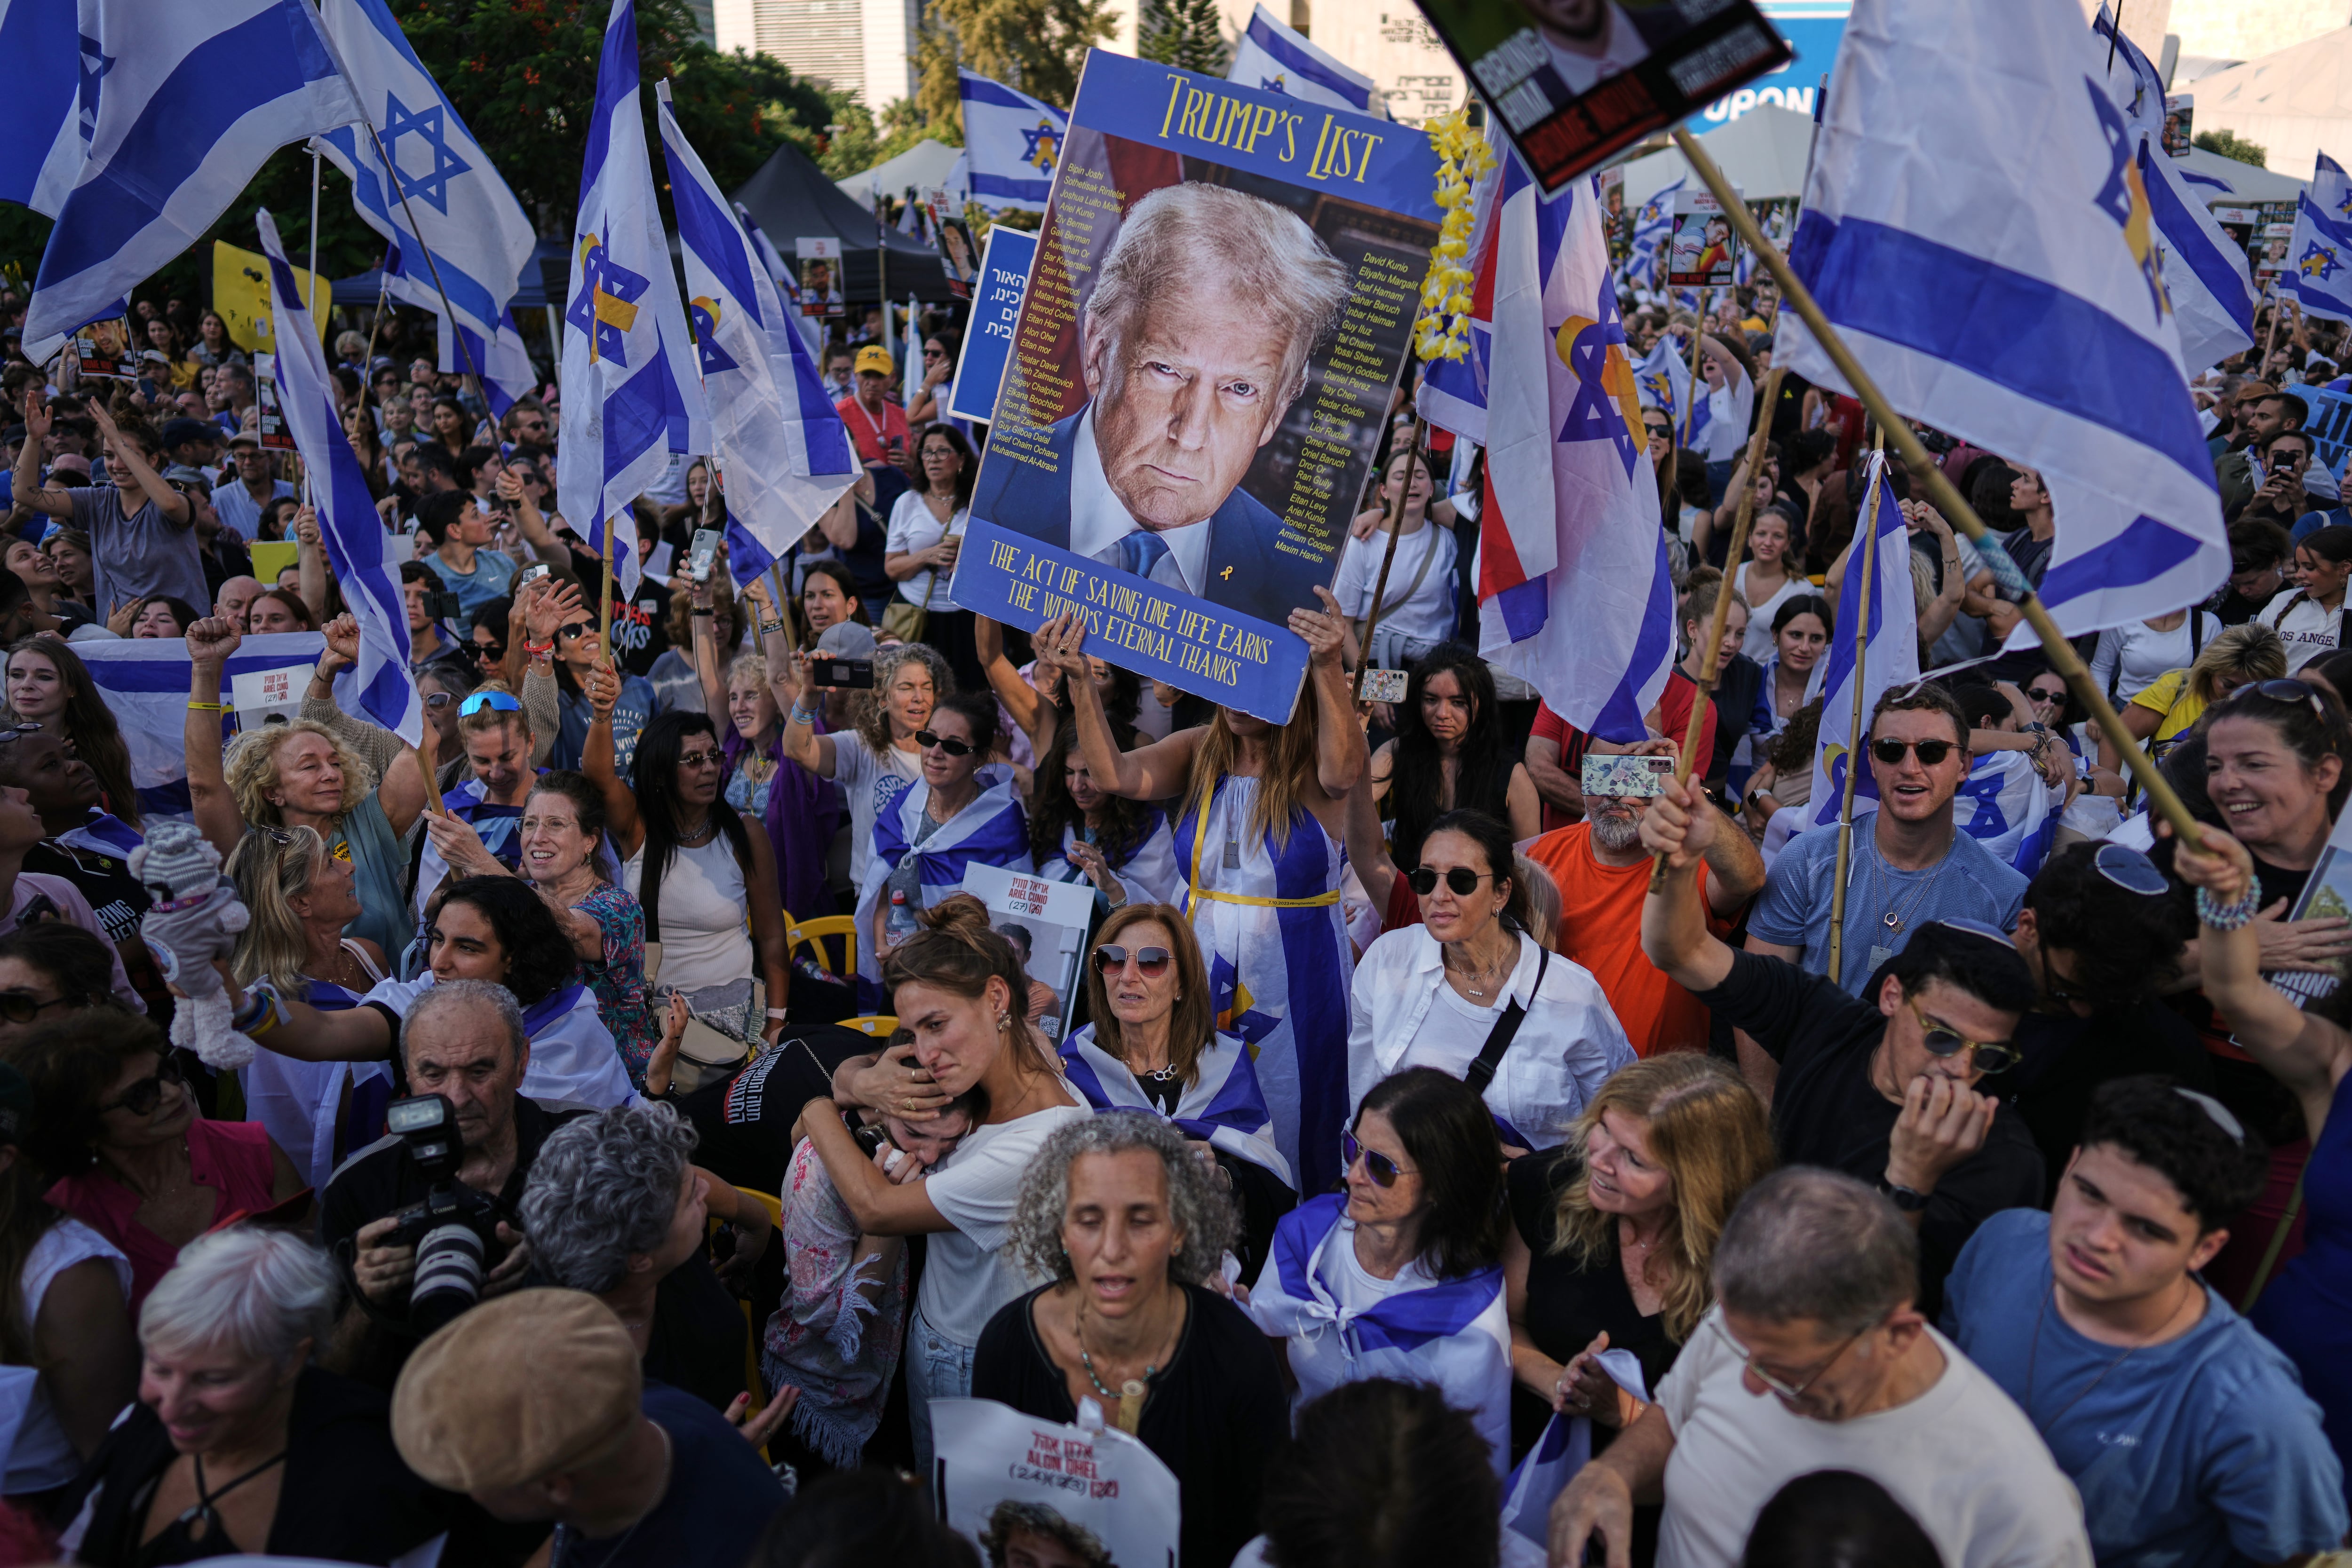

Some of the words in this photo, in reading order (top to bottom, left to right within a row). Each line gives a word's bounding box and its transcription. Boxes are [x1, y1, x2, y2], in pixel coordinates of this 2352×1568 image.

[1472, 26, 1549, 97] BRING
[1496, 78, 1553, 135] HIM
[1306, 114, 1383, 183] LIST
[1067, 163, 1085, 174] Bipin
[1085, 168, 1104, 180] Joshi
[1064, 176, 1097, 191] Sothetisak
[1099, 186, 1126, 200] Rintelak
[1060, 190, 1084, 202] Joshua
[1085, 197, 1101, 207] Luito
[1103, 201, 1124, 213] Mollel
[1060, 203, 1075, 212] Ariel
[1076, 207, 1095, 219] Kunio
[1067, 218, 1093, 231] Berman
[1050, 226, 1064, 236] Gali
[1065, 231, 1091, 245] Berman
[1047, 239, 1080, 254] Avinathan
[1081, 249, 1090, 258] Or
[1043, 251, 1056, 261] Bar
[1057, 256, 1091, 273] Kuperstein
[1363, 253, 1387, 266] David
[1386, 260, 1409, 273] Kunio
[1041, 264, 1057, 275] Omri
[1058, 270, 1076, 281] Miran
[1359, 267, 1387, 282] Eliyahu
[1387, 274, 1418, 290] Margalit
[1670, 274, 1686, 282] HOME
[990, 288, 1025, 304] כינו,
[1037, 277, 1054, 287] Tamir
[1055, 283, 1081, 296] Nimrodi
[1354, 280, 1374, 292] Asaf
[1373, 287, 1406, 301] Hamami
[1034, 289, 1055, 301] Matan
[1056, 297, 1081, 309] angrest
[1350, 293, 1373, 306] Sahar
[1374, 301, 1400, 315] Baruch
[1026, 313, 1043, 324] Eitan
[1030, 301, 1054, 315] Nimrod
[1055, 309, 1076, 322] Cohen
[1346, 307, 1367, 318] Inbar
[1367, 313, 1397, 328] Haiman
[1024, 326, 1039, 336] Alon
[1041, 331, 1057, 342] Ohel
[1342, 320, 1358, 332] Guy
[1020, 338, 1037, 349] Eitan
[1038, 346, 1052, 354] mor
[1338, 333, 1348, 343] Tal
[1350, 338, 1375, 351] Chaimi
[1017, 352, 1040, 365] Eviatar
[1040, 359, 1059, 372] David
[1334, 345, 1352, 357] Yossi
[1354, 352, 1383, 366] Sharabi
[1013, 363, 1032, 375] Aryeh
[1033, 369, 1074, 389] Zalmanovich
[1328, 357, 1354, 372] Manny
[1356, 366, 1389, 382] Goddard
[1010, 375, 1031, 388] Segev
[1032, 382, 1062, 398] Chalphon
[1324, 371, 1348, 383] Daniel
[1349, 378, 1371, 391] Perez
[1007, 388, 1028, 400] Elkana
[1029, 395, 1065, 412] Boochboot
[1322, 384, 1336, 395] Itay
[1337, 388, 1357, 400] Chen
[1004, 399, 1019, 408] Rom
[1020, 404, 1055, 423] Breslavsky
[1317, 396, 1341, 410] Hadar
[1341, 404, 1366, 418] Goldin
[262, 415, 281, 425] BRING
[1001, 410, 1020, 422] Matan
[1021, 416, 1056, 434] Zangauker
[1310, 422, 1324, 433] Lior
[1313, 410, 1324, 420] Oz
[1326, 414, 1350, 427] Daniel
[998, 421, 1010, 430] Guy
[1013, 426, 1032, 438] Gilboa
[1033, 433, 1051, 444] Dalal
[994, 431, 1012, 443] Yosef
[1012, 438, 1033, 450] Chaim
[1034, 445, 1059, 459] Ochana
[1305, 435, 1326, 447] Omer
[1327, 443, 1351, 457] Nautra
[991, 444, 1030, 462] Muhammad
[1028, 457, 1058, 473] Al-Atrash
[1298, 459, 1315, 469] Dror
[1302, 447, 1319, 459] Oriel
[1320, 453, 1346, 468] Baruch
[1296, 470, 1312, 480] Ran
[1293, 481, 1312, 493] Tamir
[1312, 489, 1331, 499] Adar
[1289, 493, 1309, 505] Eitan
[1310, 501, 1327, 513] Levy
[1287, 506, 1304, 515] Ariel
[1305, 512, 1326, 523] Kunio
[1283, 515, 1307, 529] Ronen
[1308, 525, 1330, 537] Engel
[1278, 528, 1306, 542] Amiram
[1308, 538, 1335, 552] Cooper
[1275, 541, 1299, 555] Maxim
[1299, 549, 1323, 563] Harkin
[989, 539, 1021, 573] THE
[1022, 554, 1058, 586] ACT
[1059, 566, 1084, 595] OF
[1086, 576, 1142, 618] SAVING
[1143, 597, 1176, 631] ONE
[1176, 608, 1215, 644] LIFE
[1216, 623, 1272, 665] EARNS
[1007, 578, 1039, 612] THE
[1104, 615, 1174, 663] ETERNAL
[1178, 641, 1241, 687] THANKS
[2280, 631, 2295, 641] OS
[2297, 633, 2335, 647] ANGE
[263, 685, 276, 693] ARIEL
[277, 681, 288, 691] CUNIO
[265, 694, 278, 704] (27)
[1008, 888, 1026, 900] ARIEL
[1028, 892, 1048, 905] CUNIO
[1030, 880, 1049, 894] אריאל
[94, 899, 136, 930] RING
[1009, 900, 1027, 912] (27)
[433, 1204, 456, 1214] Canon
[1027, 1449, 1061, 1472] ALON
[1066, 1457, 1098, 1480] OHEL
